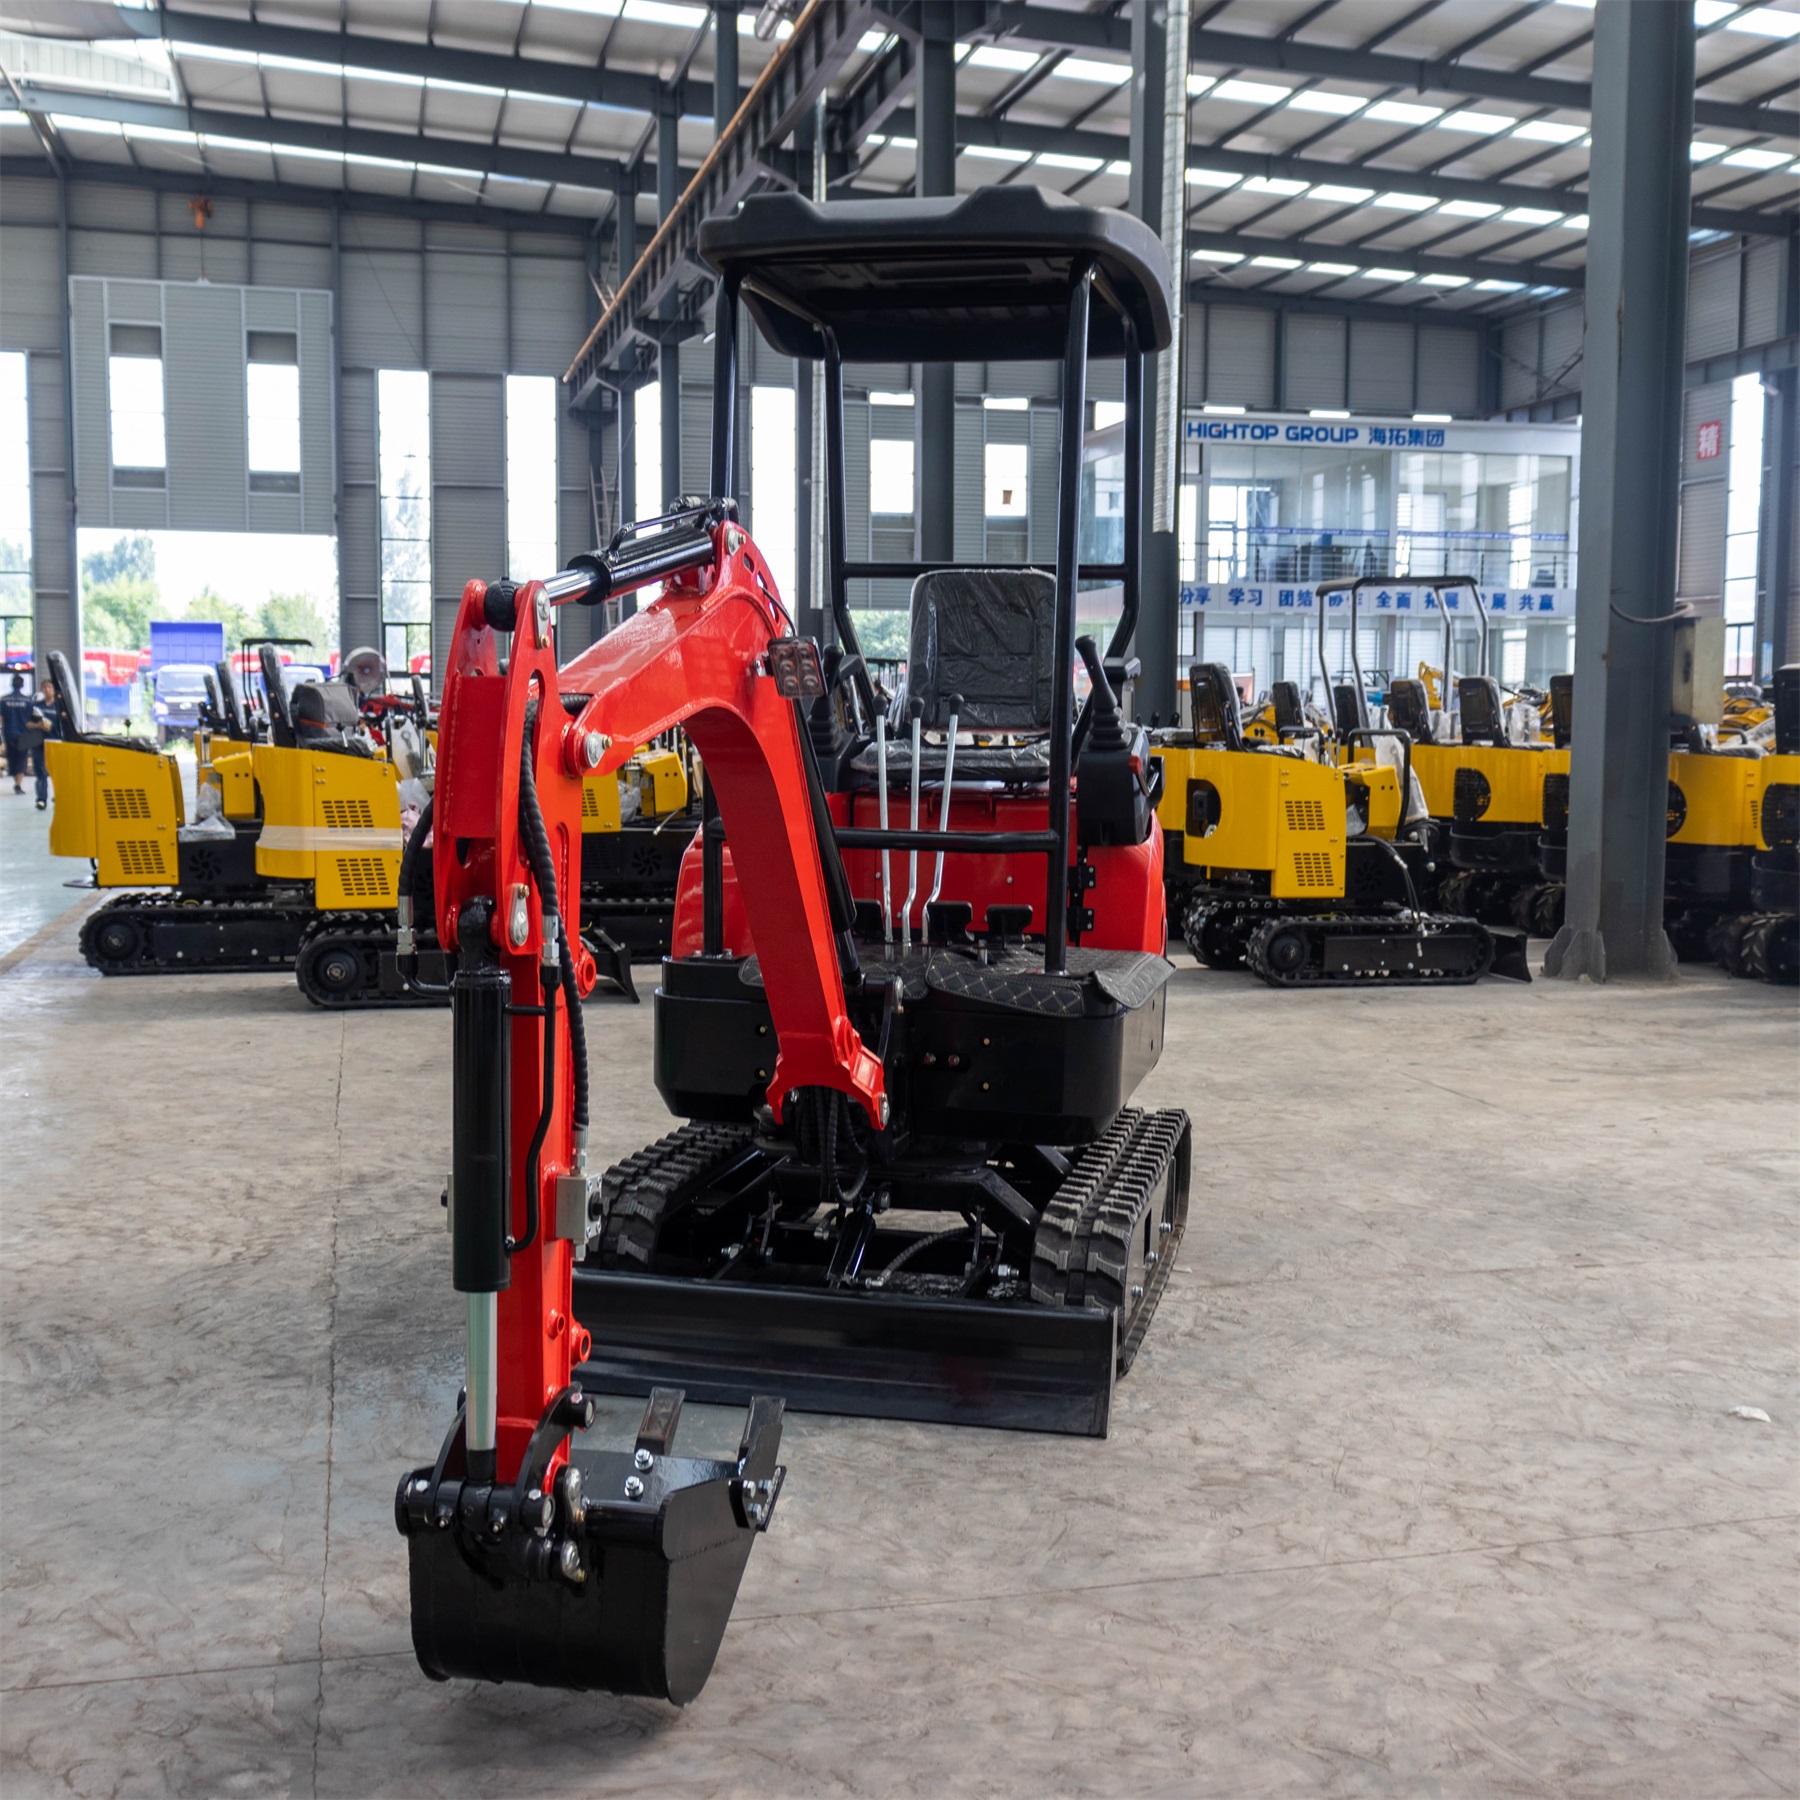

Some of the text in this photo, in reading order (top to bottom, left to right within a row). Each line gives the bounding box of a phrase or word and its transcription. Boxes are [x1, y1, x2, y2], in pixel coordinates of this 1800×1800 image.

[1187, 422, 1446, 447] HIGHTOP GROUP 海拓集团
[1228, 587, 1263, 606] 学习
[1278, 589, 1314, 607] 团结
[1376, 590, 1412, 609] 全面
[1519, 594, 1555, 611] 共赢
